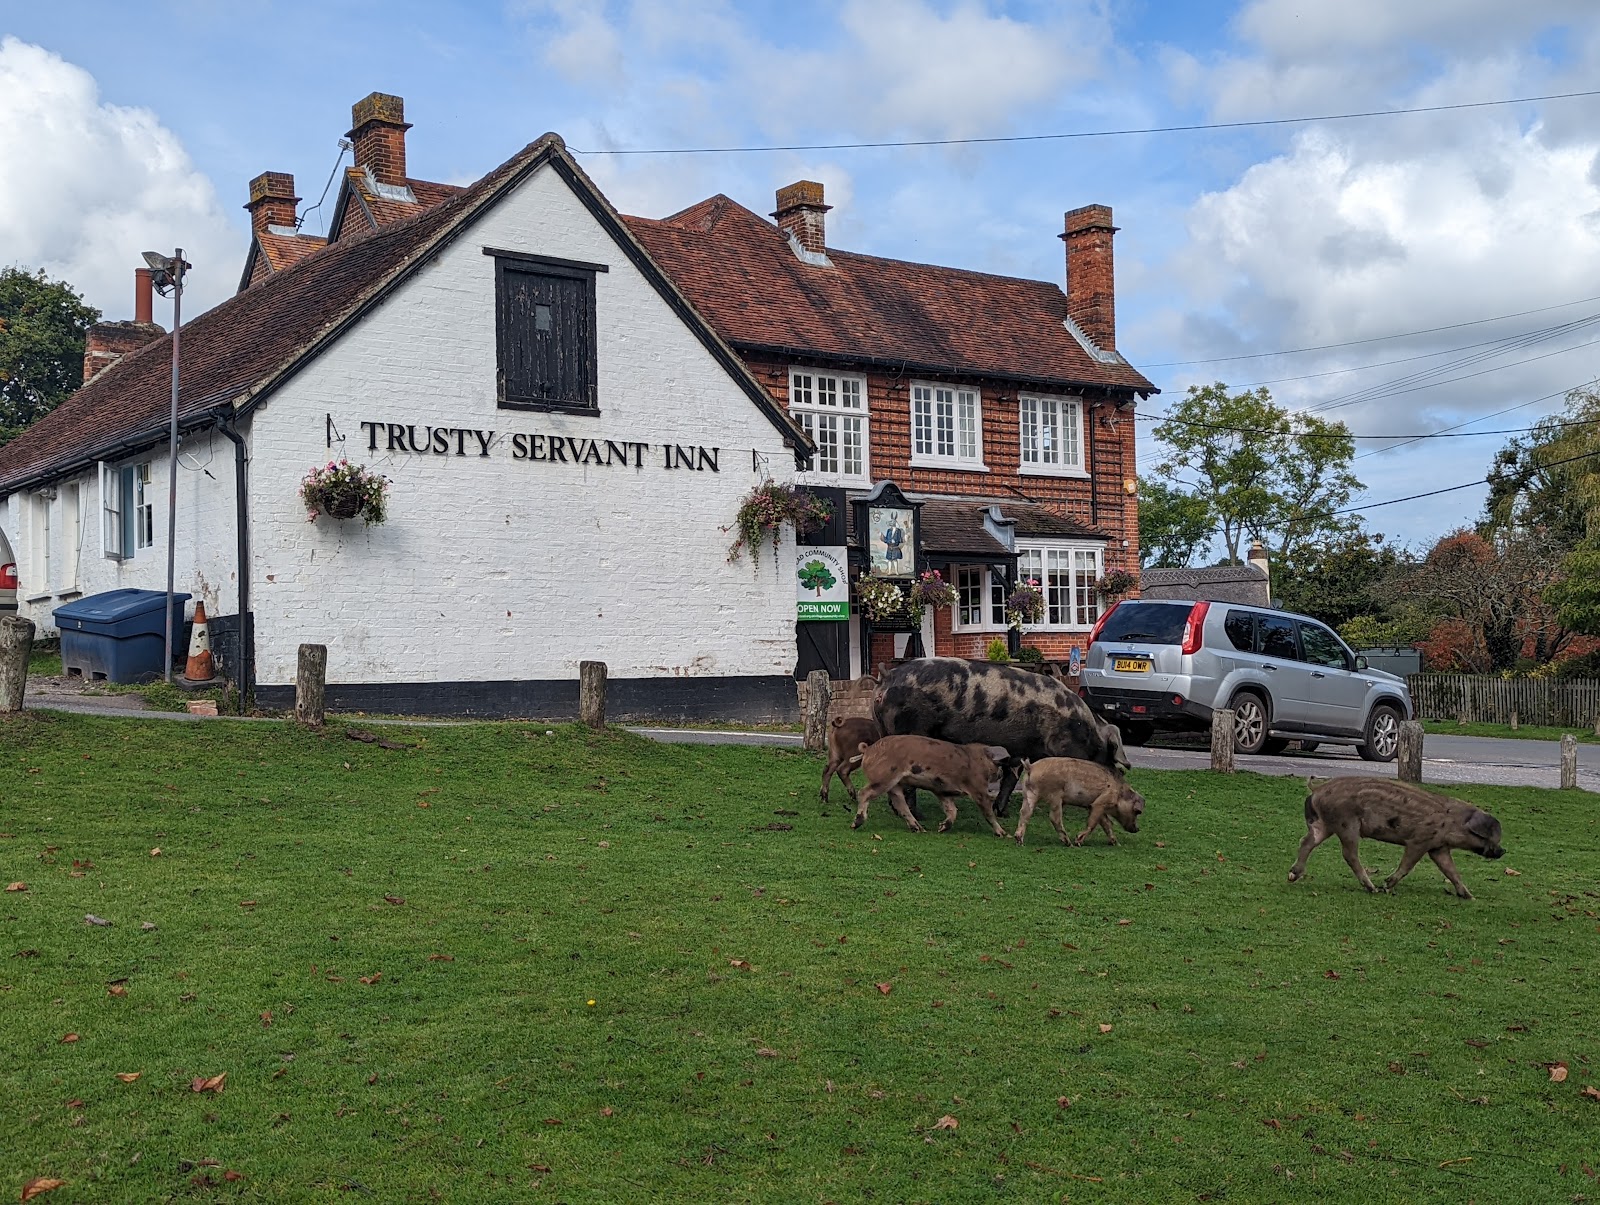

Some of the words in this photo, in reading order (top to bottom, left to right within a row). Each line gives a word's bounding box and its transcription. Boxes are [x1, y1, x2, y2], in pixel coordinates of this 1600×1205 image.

[360, 421, 495, 457] TRUSTY
[512, 433, 649, 467] SERVANT
[663, 443, 720, 472] INN
[805, 549, 840, 567] COMMUNITY
[837, 566, 848, 585] SHOP
[797, 604, 819, 613] OPEN
[820, 604, 841, 613] NOW
[1116, 660, 1131, 670] BU14
[1132, 661, 1148, 670] OWR
